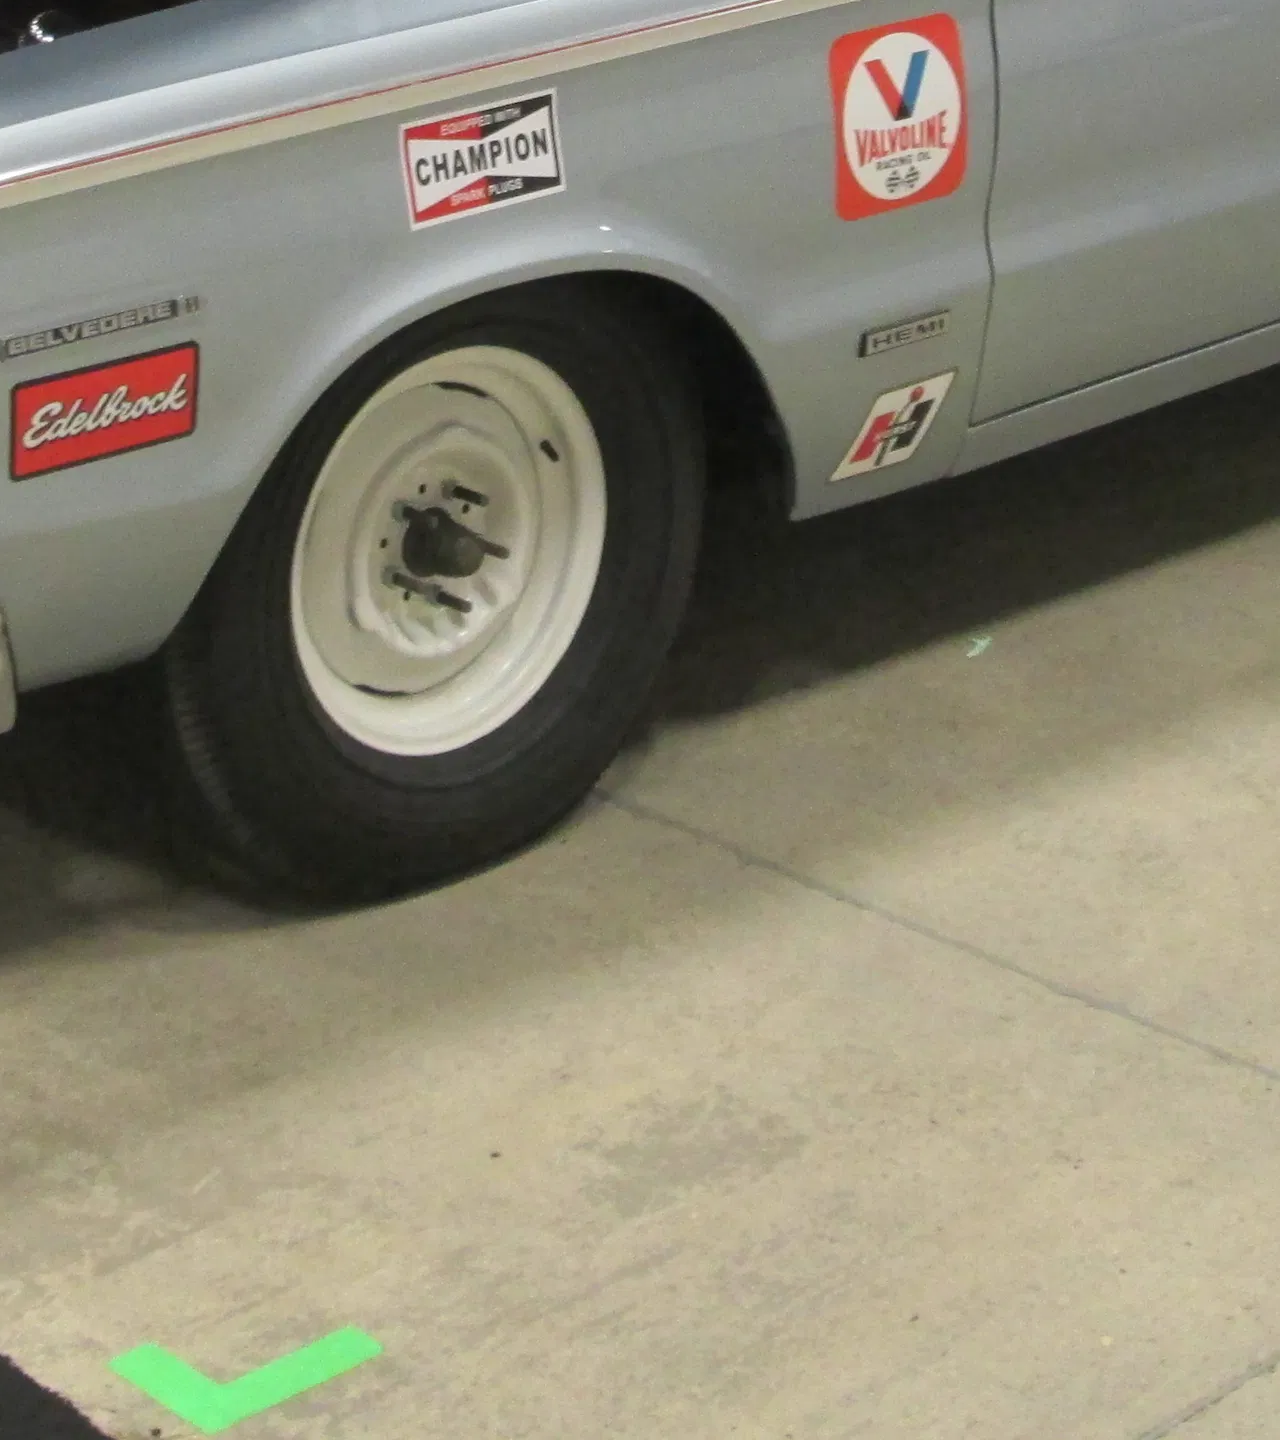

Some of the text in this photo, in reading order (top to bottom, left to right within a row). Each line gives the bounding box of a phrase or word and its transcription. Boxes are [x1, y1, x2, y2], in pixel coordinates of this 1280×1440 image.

[415, 128, 549, 187] CHAMPION
[853, 109, 949, 168] VALVOLINE
[8, 301, 173, 355] BELVEDERE
[872, 318, 945, 348] HEMI
[22, 373, 188, 448] Edelbrock
